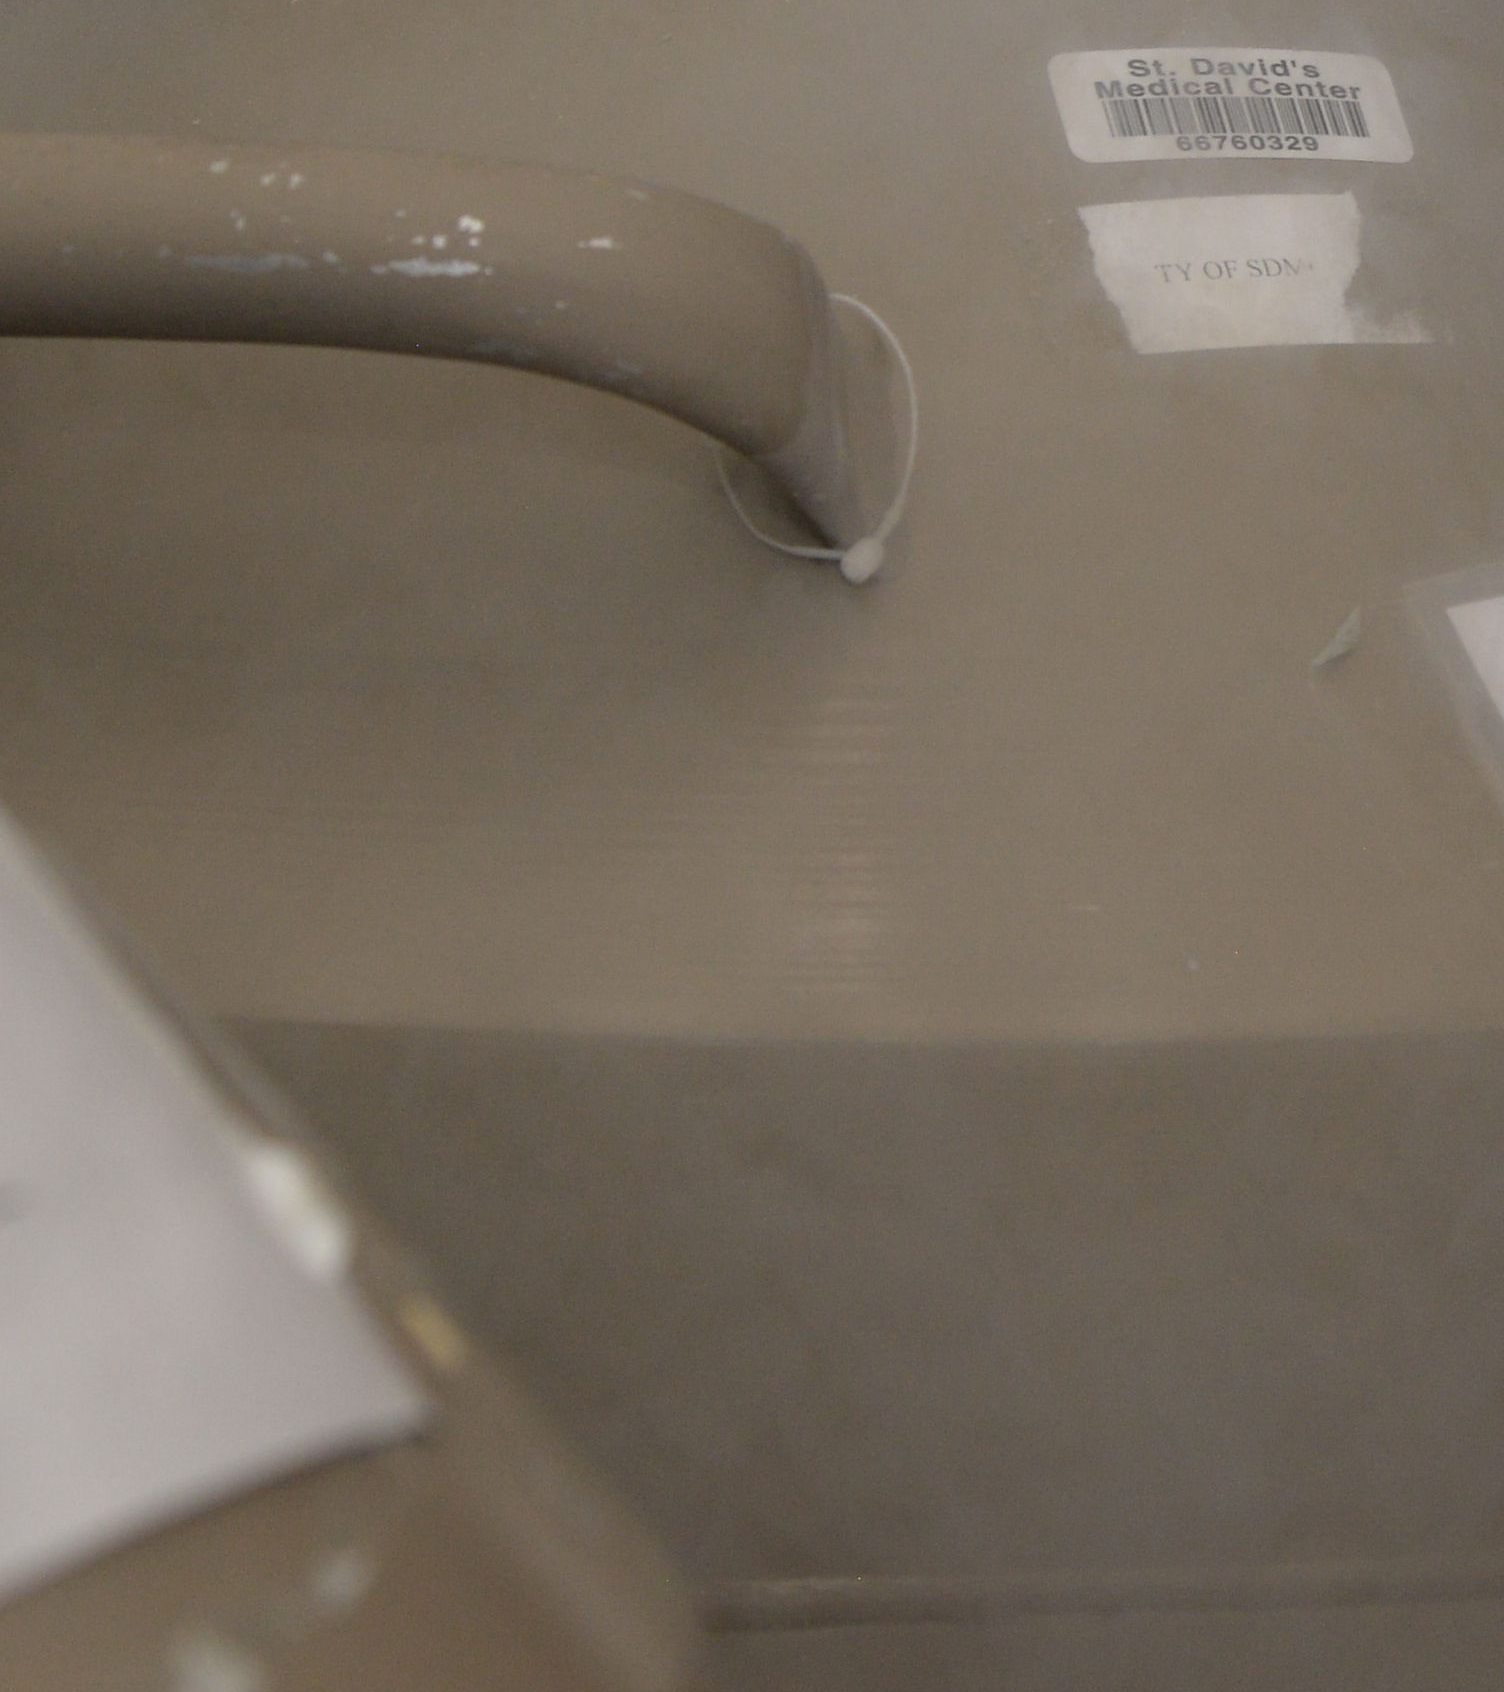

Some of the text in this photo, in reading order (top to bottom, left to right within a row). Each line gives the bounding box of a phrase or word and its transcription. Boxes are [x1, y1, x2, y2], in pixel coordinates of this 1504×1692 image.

[1127, 57, 1321, 79] St. David's
[1094, 77, 1361, 100] Medical Center
[1176, 134, 1319, 152] 66760329
[1203, 260, 1237, 280] OF
